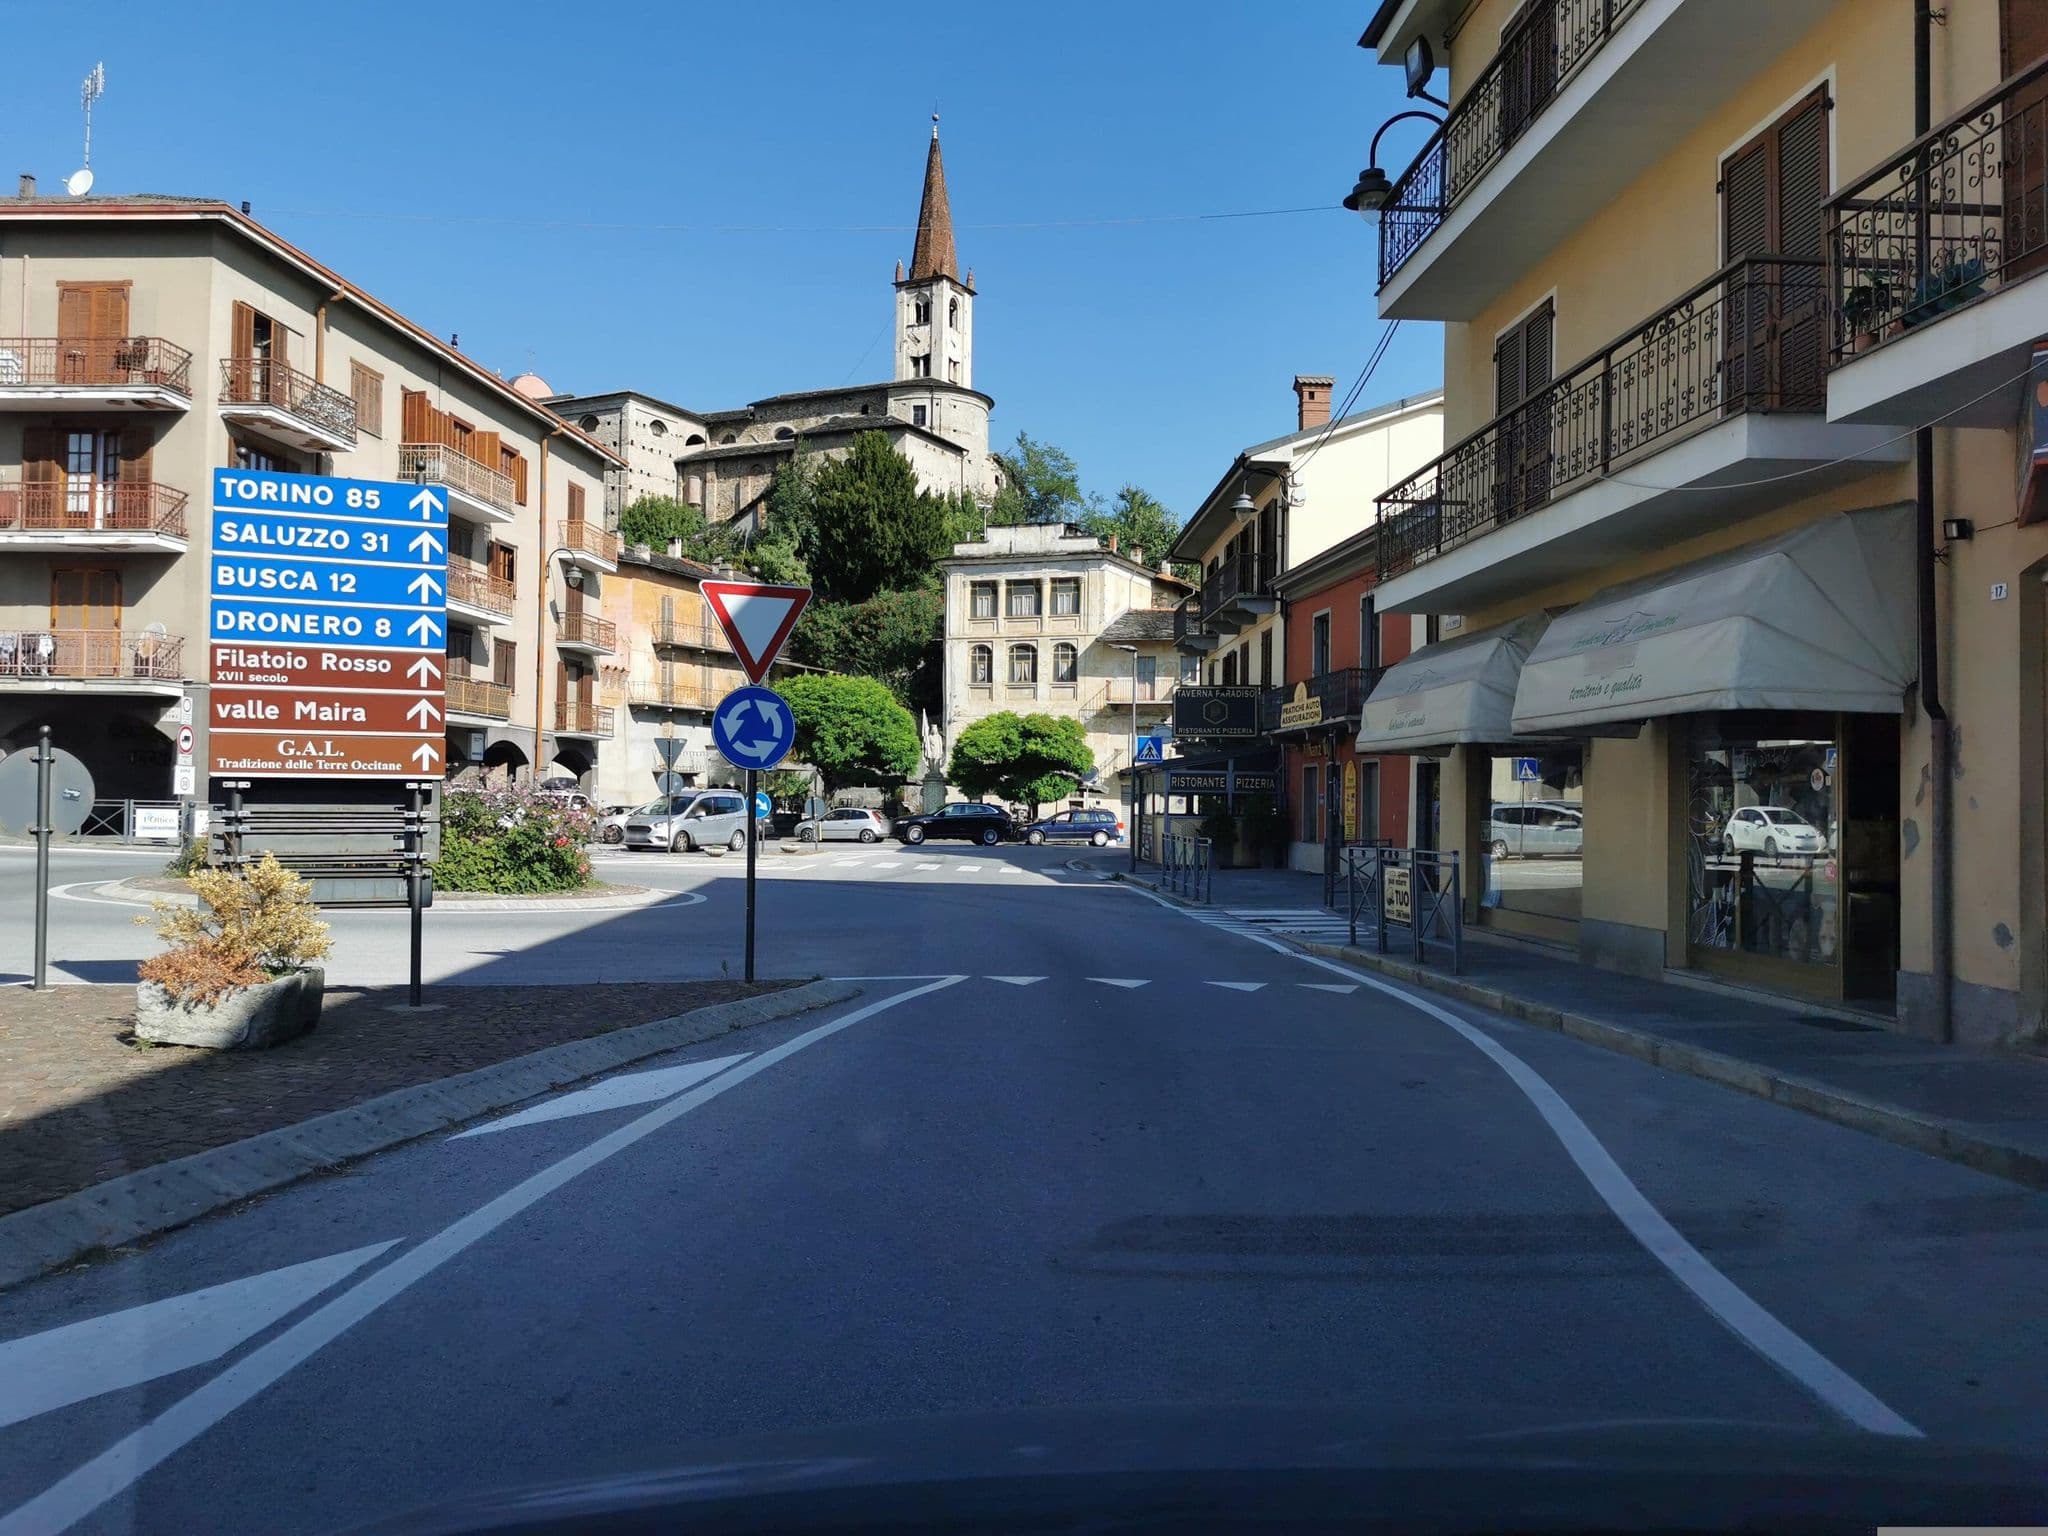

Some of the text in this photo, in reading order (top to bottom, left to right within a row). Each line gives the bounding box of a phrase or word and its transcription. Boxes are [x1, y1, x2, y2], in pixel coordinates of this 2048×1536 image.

[220, 477, 380, 509] TORINO 85
[220, 522, 389, 553] SALUZZO 31
[217, 565, 356, 593] BUSCA 12
[1995, 585, 2003, 598] 17
[216, 610, 391, 638] DRONERO 8
[216, 649, 392, 673] Filatoio Rosso
[217, 672, 288, 684] XVII secolo
[1177, 689, 1255, 698] TAVERNA PARADISO
[217, 700, 366, 722] valle Maira
[1283, 700, 1320, 715] PRATICHE AUTO
[1282, 711, 1320, 724] ASSICURAZIONI
[278, 739, 345, 757] G.A.L.
[217, 758, 403, 771] Tradizione delle Terre Occitane
[1171, 777, 1275, 789] RISTORANTE PIZZERIA
[1395, 890, 1409, 907] TUO
